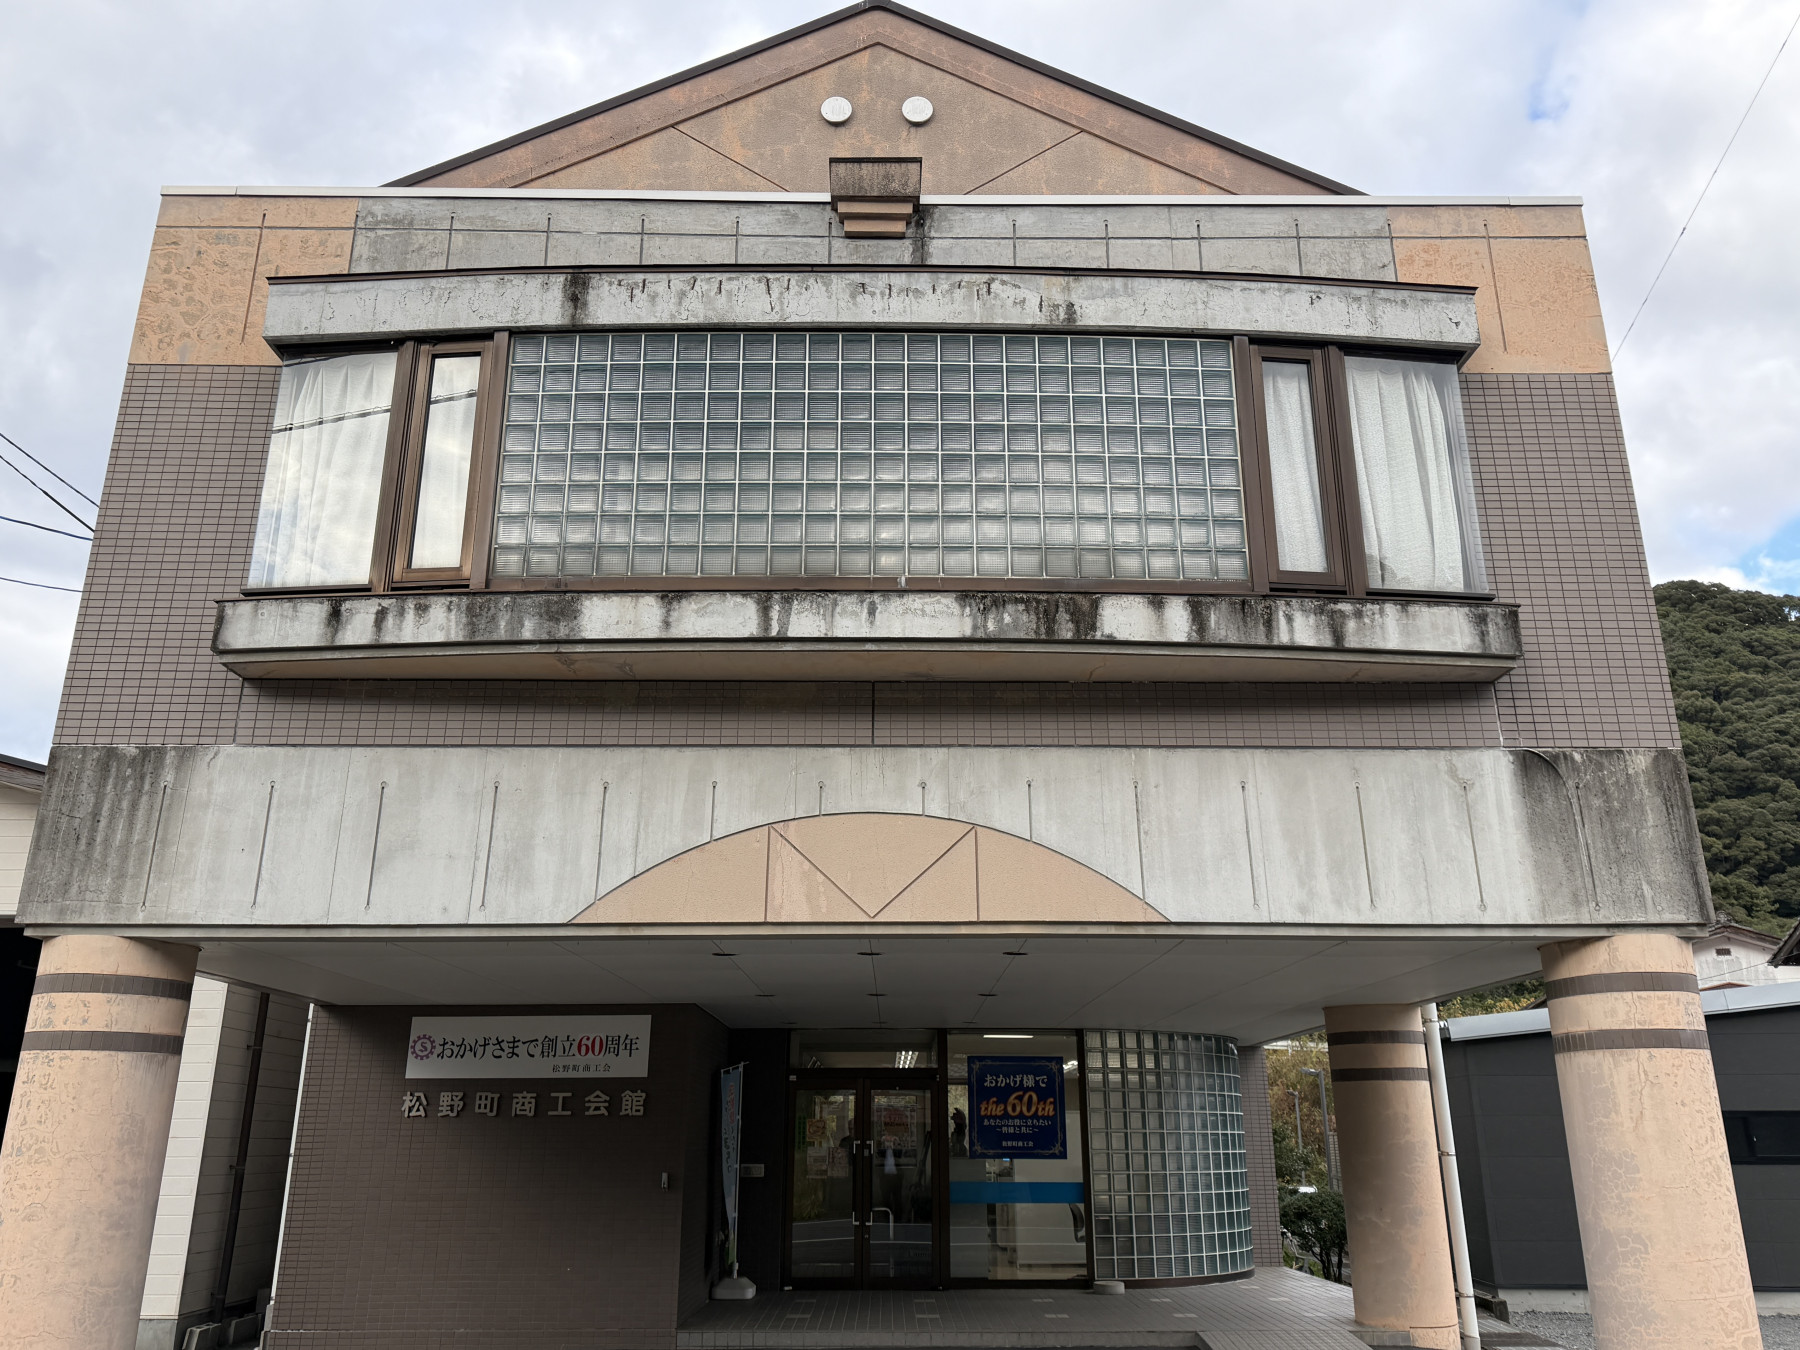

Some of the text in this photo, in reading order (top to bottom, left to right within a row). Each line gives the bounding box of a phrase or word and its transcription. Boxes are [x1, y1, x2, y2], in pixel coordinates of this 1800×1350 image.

[436, 1034, 640, 1060] おかげさまで創立60周年
[552, 1063, 611, 1074] 松野町商工会
[984, 1074, 1048, 1088] おかげ様で
[401, 1089, 647, 1118] 松野町商工会館
[980, 1091, 1055, 1117] the 60th
